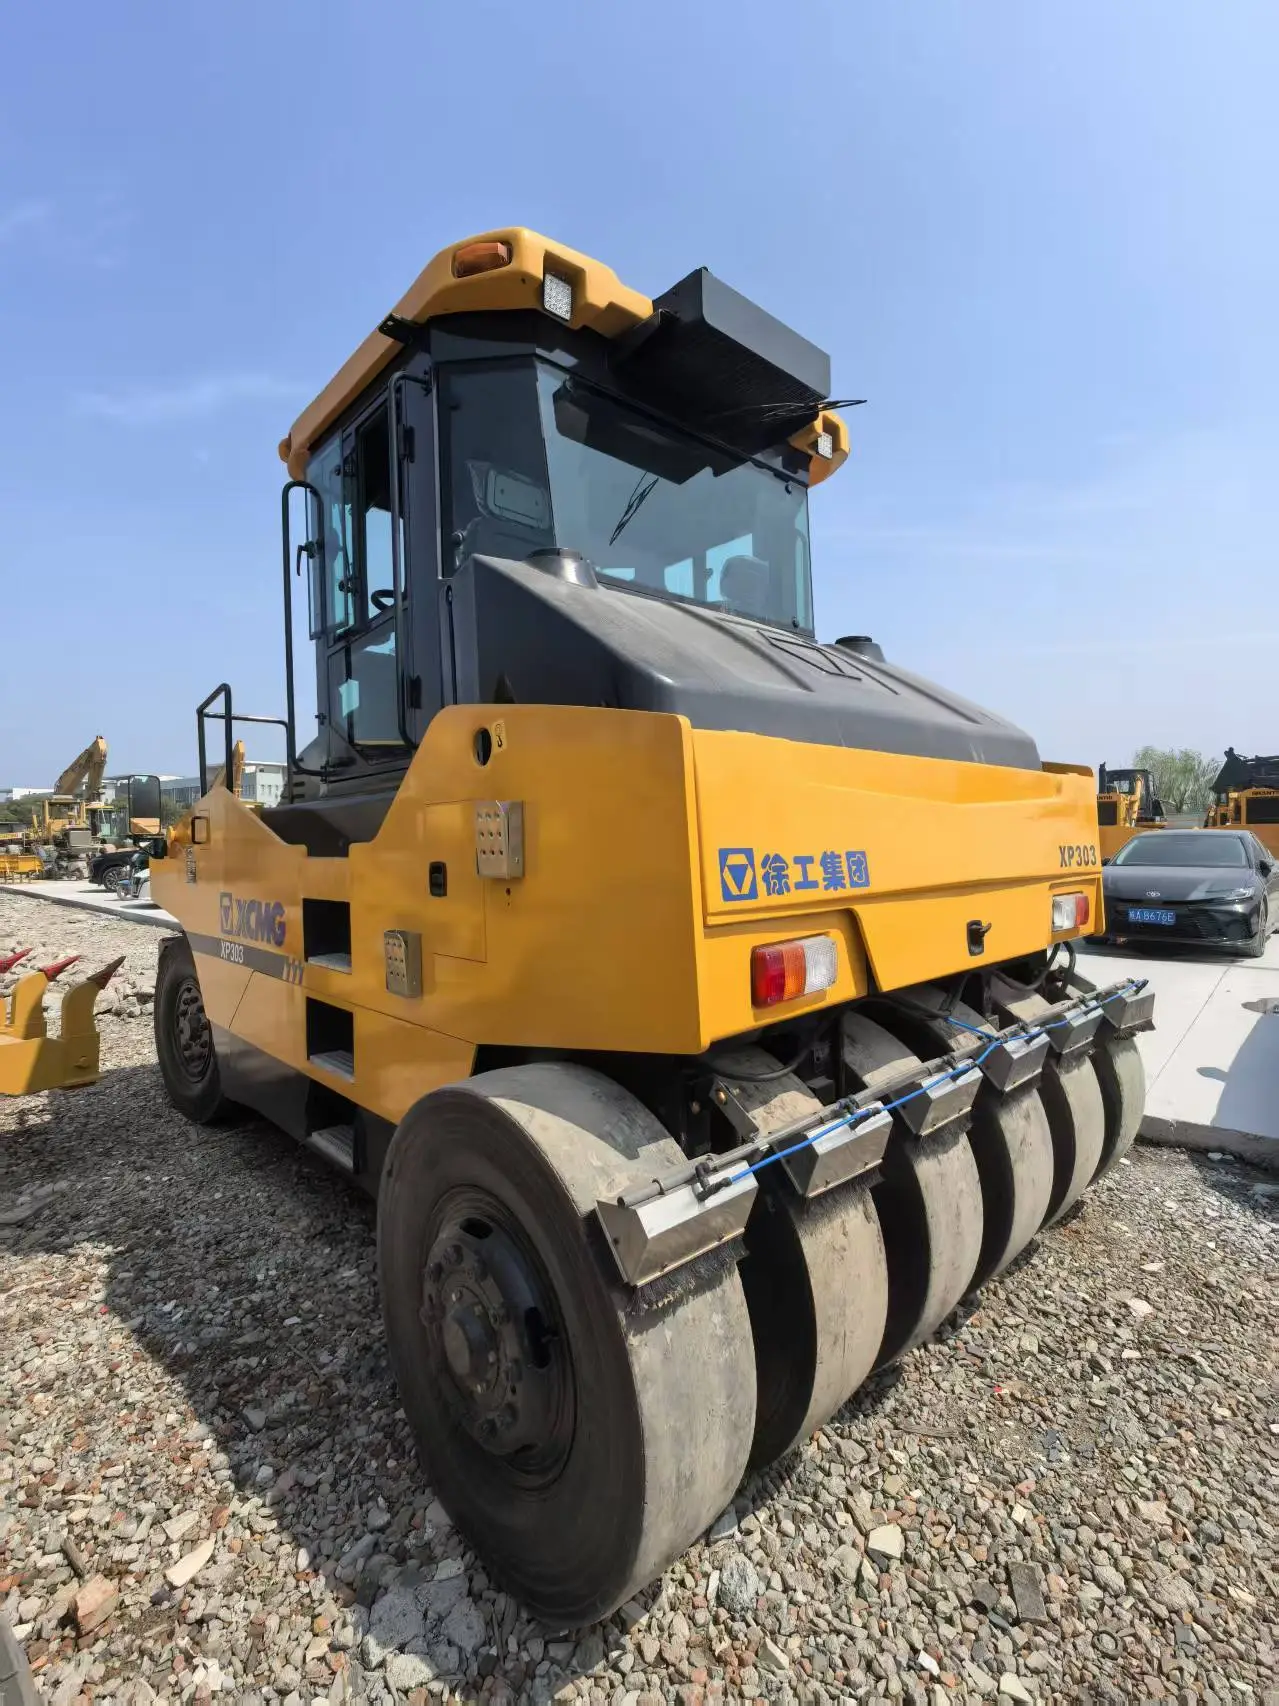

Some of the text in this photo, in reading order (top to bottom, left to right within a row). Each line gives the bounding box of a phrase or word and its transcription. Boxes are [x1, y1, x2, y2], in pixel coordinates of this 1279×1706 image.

[1059, 845, 1097, 867] XP303
[760, 851, 870, 896] 徐工集团
[232, 899, 286, 947] XCMG
[220, 940, 244, 963] XP303
